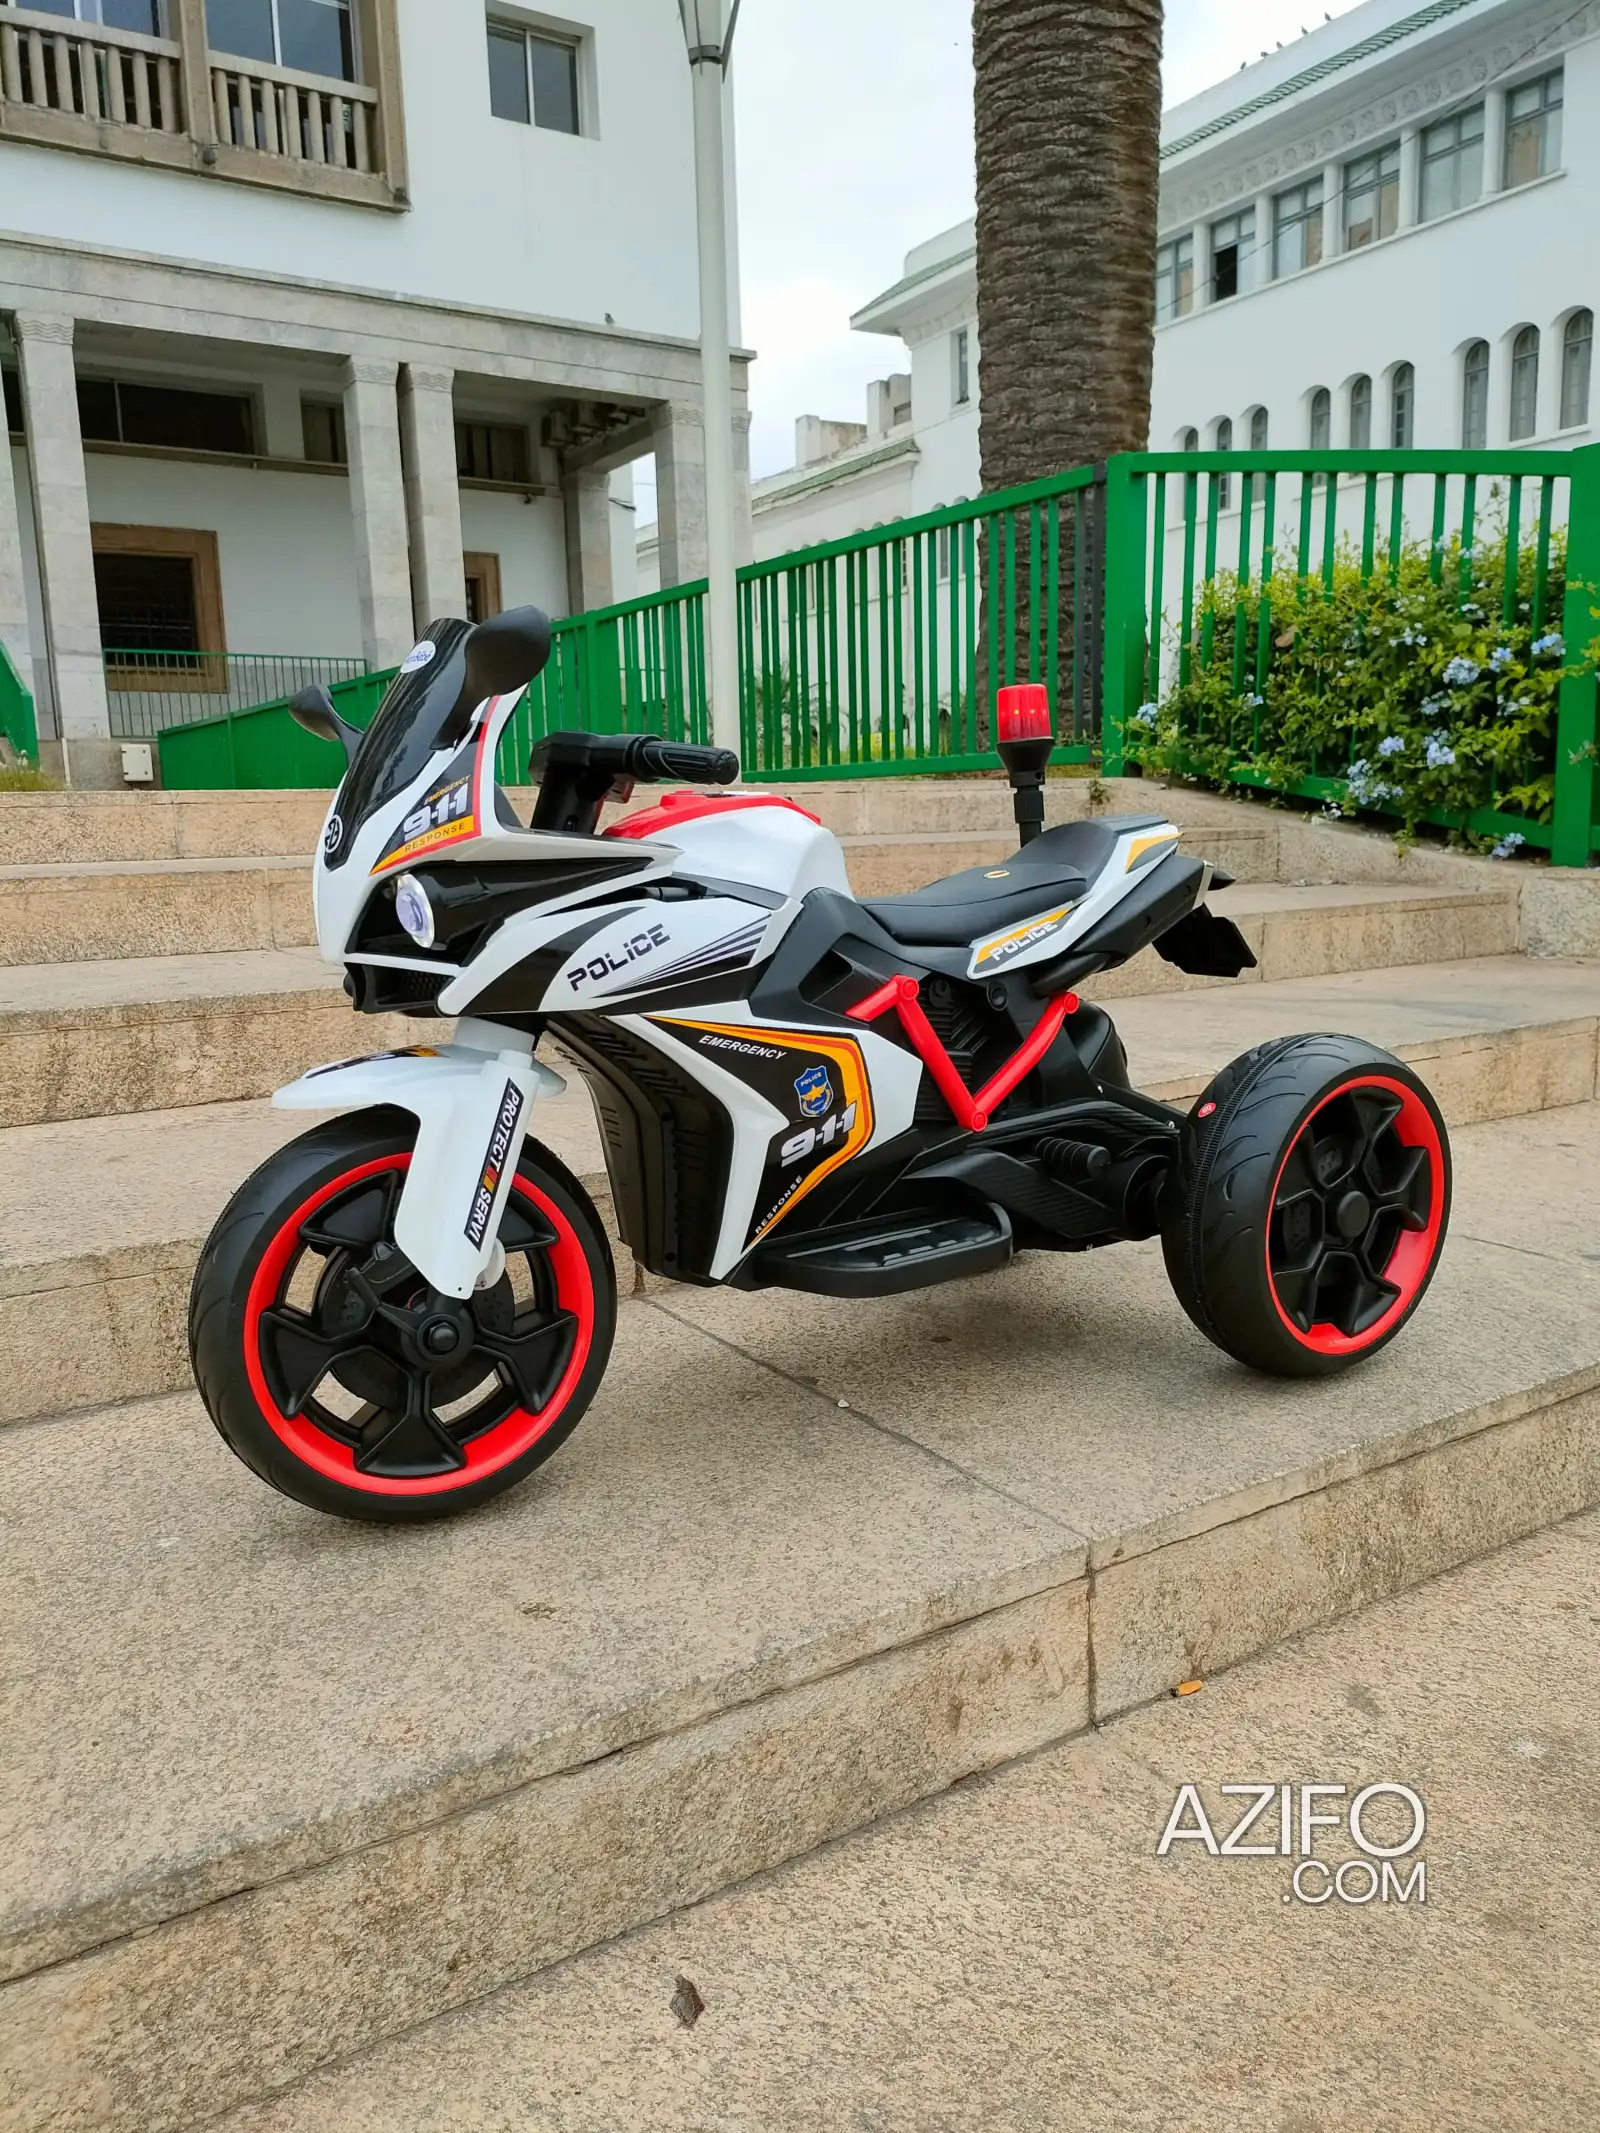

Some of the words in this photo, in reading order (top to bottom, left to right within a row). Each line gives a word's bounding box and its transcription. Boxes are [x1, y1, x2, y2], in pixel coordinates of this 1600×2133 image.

[424, 774, 471, 806] EMERGENCY
[404, 822, 465, 853] RESPONSE
[698, 1034, 787, 1060] EMERGENCY
[800, 1072, 822, 1087] POLICE
[490, 1088, 519, 1173] PROTECT
[469, 1187, 492, 1243] SERVI
[754, 1175, 803, 1234] RESPONSE
